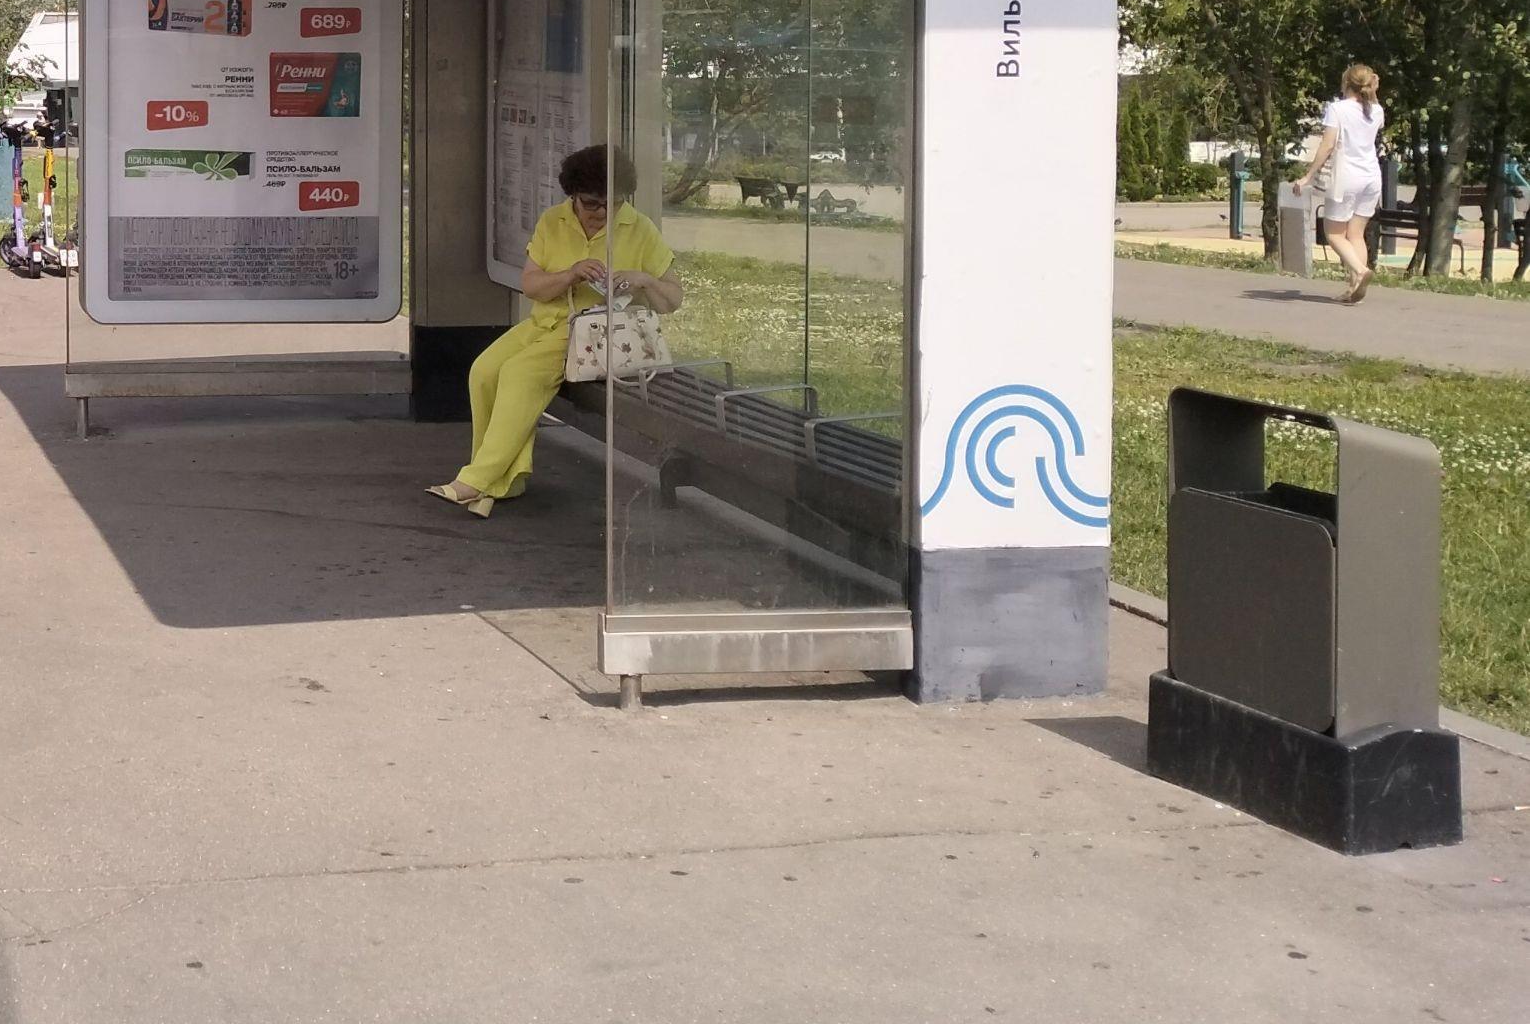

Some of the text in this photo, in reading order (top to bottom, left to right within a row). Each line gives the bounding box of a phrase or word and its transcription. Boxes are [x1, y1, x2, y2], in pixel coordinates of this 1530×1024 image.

[204, 0, 226, 32] 2
[280, 64, 327, 78] Ренни
[154, 105, 200, 122] -10%
[333, 260, 359, 280] 18+
